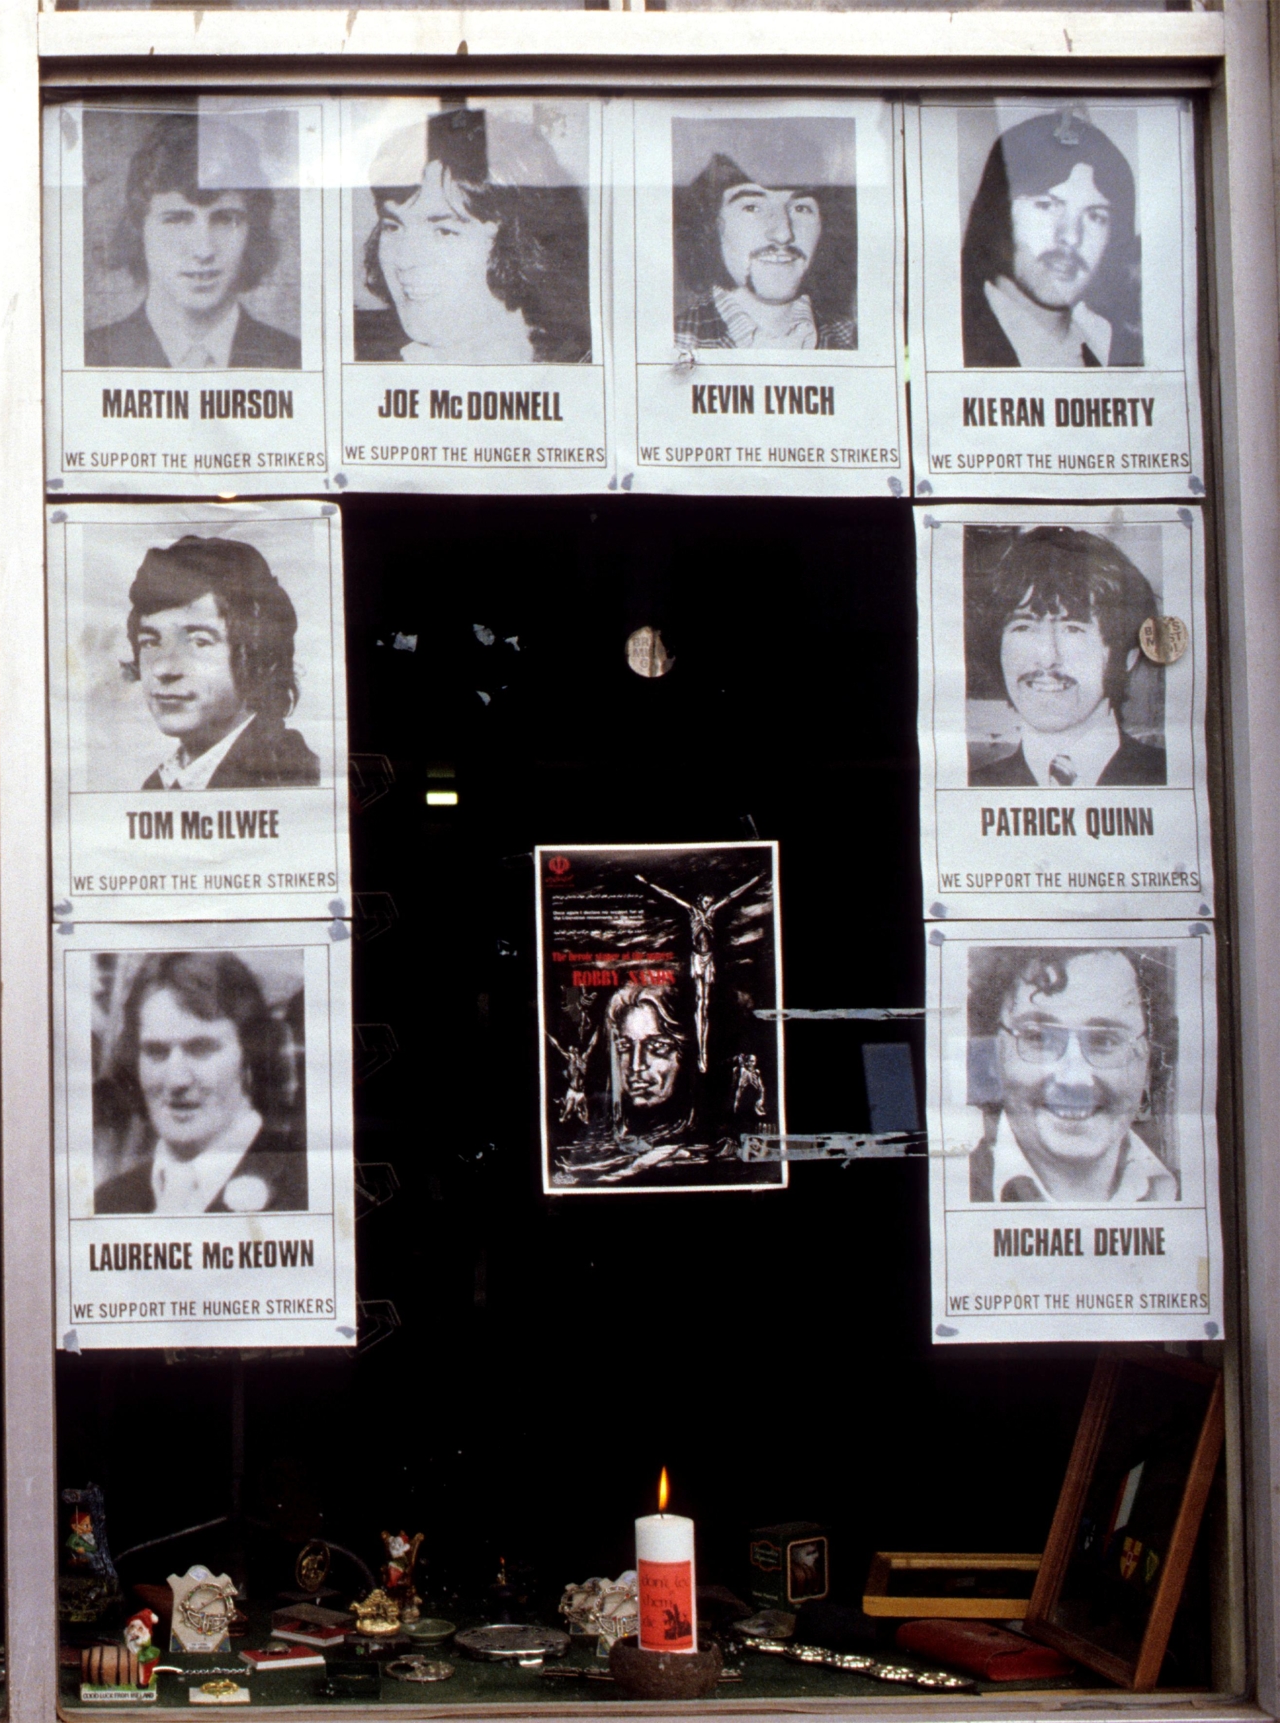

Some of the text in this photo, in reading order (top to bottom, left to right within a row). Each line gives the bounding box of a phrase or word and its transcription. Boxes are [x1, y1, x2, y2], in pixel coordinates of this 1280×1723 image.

[102, 388, 294, 419] MARTIN HURSON
[378, 388, 419, 419] JOE
[691, 384, 835, 415] KEVIN LYNCH
[963, 397, 1155, 428] KIERAN DOHERTY
[65, 451, 325, 468] WE SUPPORT THE HUNGER STRIKERS
[345, 445, 605, 463] WE SUPPORT THE HUNGER STRIKERS
[640, 446, 898, 463] WE SUPPORT THE HUNGER STRIKERS
[931, 453, 1189, 469] WE SUPPORT THE HUNGER STRIKERS
[126, 811, 173, 839] TOM
[981, 807, 1154, 839] PATRICK QUINN
[74, 872, 336, 890] WE SUPPORT THE HUNGER STRIKERS
[941, 871, 1199, 888] WE SUPPORT THE HUNGER STRIKERS
[572, 970, 618, 986] BOBBY
[993, 1227, 1165, 1257] MICHAEL DEVINE
[89, 1242, 192, 1271] LAURENCE
[74, 1298, 334, 1318] WE SUPPORT THE HUNGER STRIKERS
[950, 1293, 1208, 1311] WE SUPPORT THE HUNGER STRIKERS
